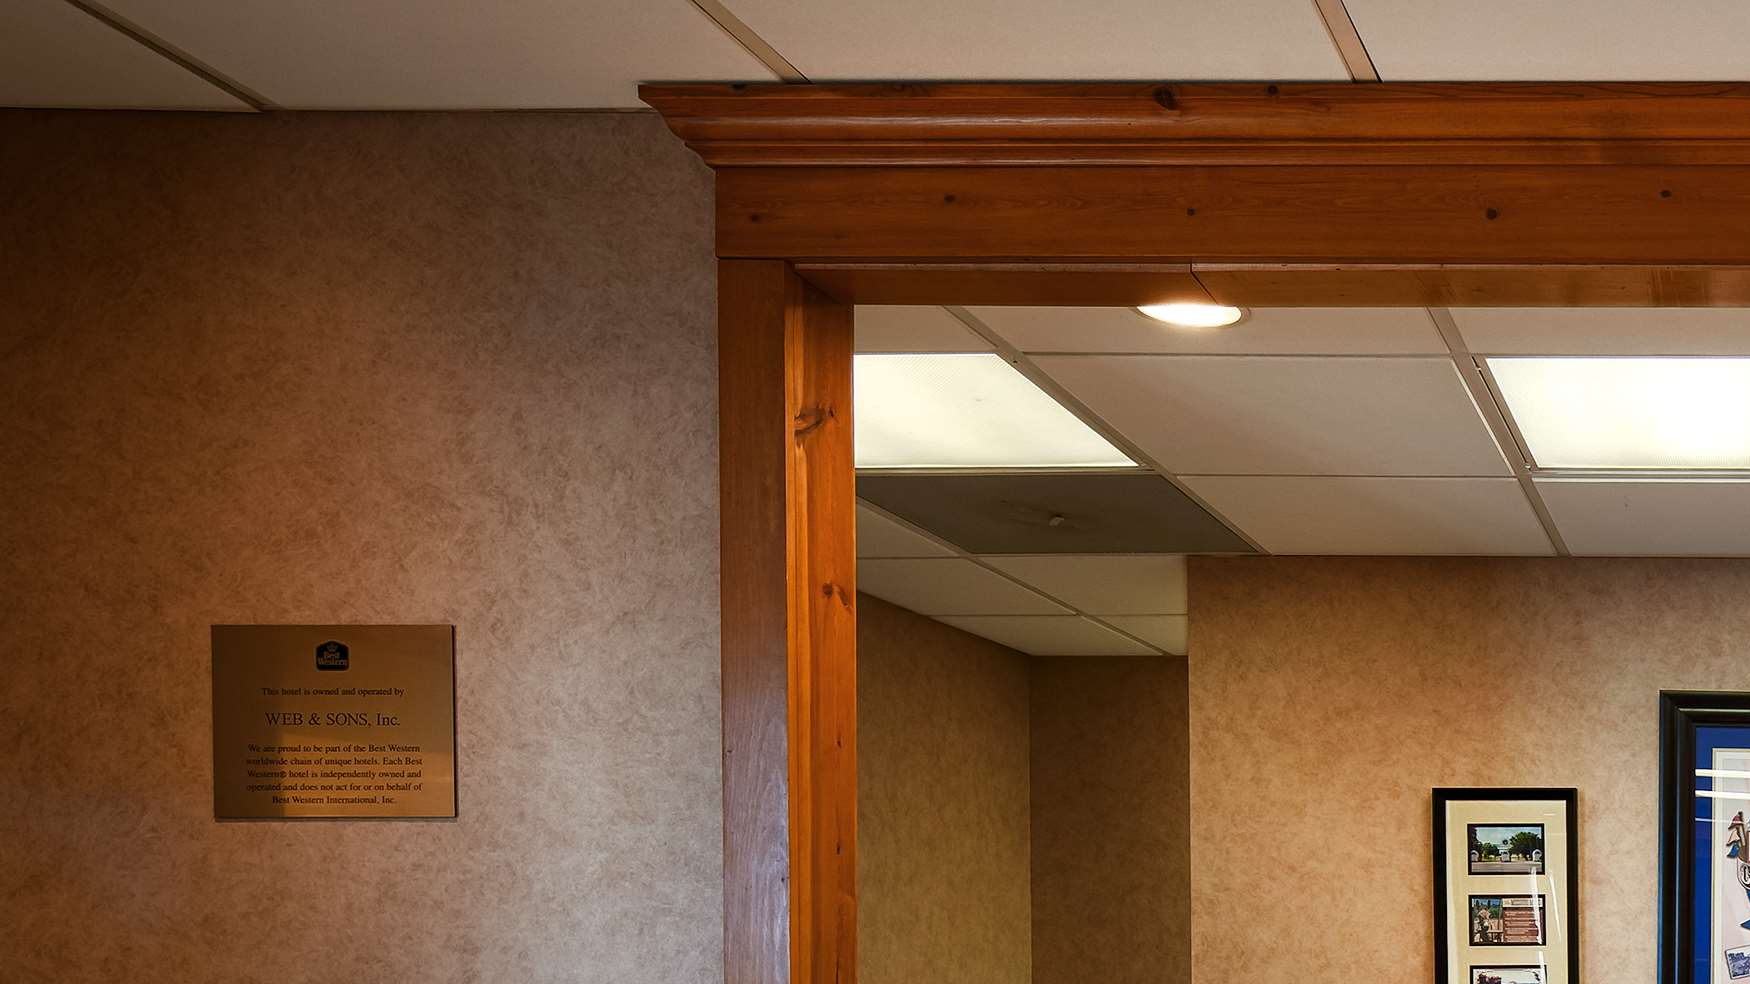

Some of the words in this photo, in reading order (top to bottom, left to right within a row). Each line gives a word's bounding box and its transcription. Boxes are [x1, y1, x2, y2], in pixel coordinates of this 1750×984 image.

[323, 651, 340, 659] Best
[318, 658, 348, 667] Western
[262, 688, 280, 696] This
[281, 687, 302, 696] hotel
[304, 688, 311, 696] is
[312, 687, 339, 696] owned
[341, 687, 356, 696] and
[357, 687, 392, 699] operated
[394, 687, 404, 699] by
[265, 712, 303, 726] WEB
[308, 712, 321, 726] &
[326, 712, 372, 727] SONS,
[376, 712, 401, 726] Inc.
[278, 744, 301, 755] proud
[303, 745, 312, 753] to
[313, 744, 323, 753] be
[325, 745, 341, 755] part
[343, 744, 352, 753] of
[353, 744, 367, 753] the
[368, 744, 386, 753] Best
[388, 744, 421, 753] Western
[290, 757, 312, 766] chain
[314, 757, 324, 766] of
[325, 758, 352, 768] unique
[383, 757, 403, 766] Each
[405, 757, 424, 766] Best
[289, 770, 309, 778] hotel
[311, 770, 318, 778] is
[320, 770, 376, 780] independently
[378, 770, 405, 778] owned
[407, 770, 422, 778] and
[246, 783, 281, 793] operated
[283, 783, 298, 791] and
[300, 783, 319, 791] does
[350, 782, 361, 791] for
[386, 782, 412, 791] behalf
[413, 782, 423, 791] of
[292, 795, 324, 804] Western
